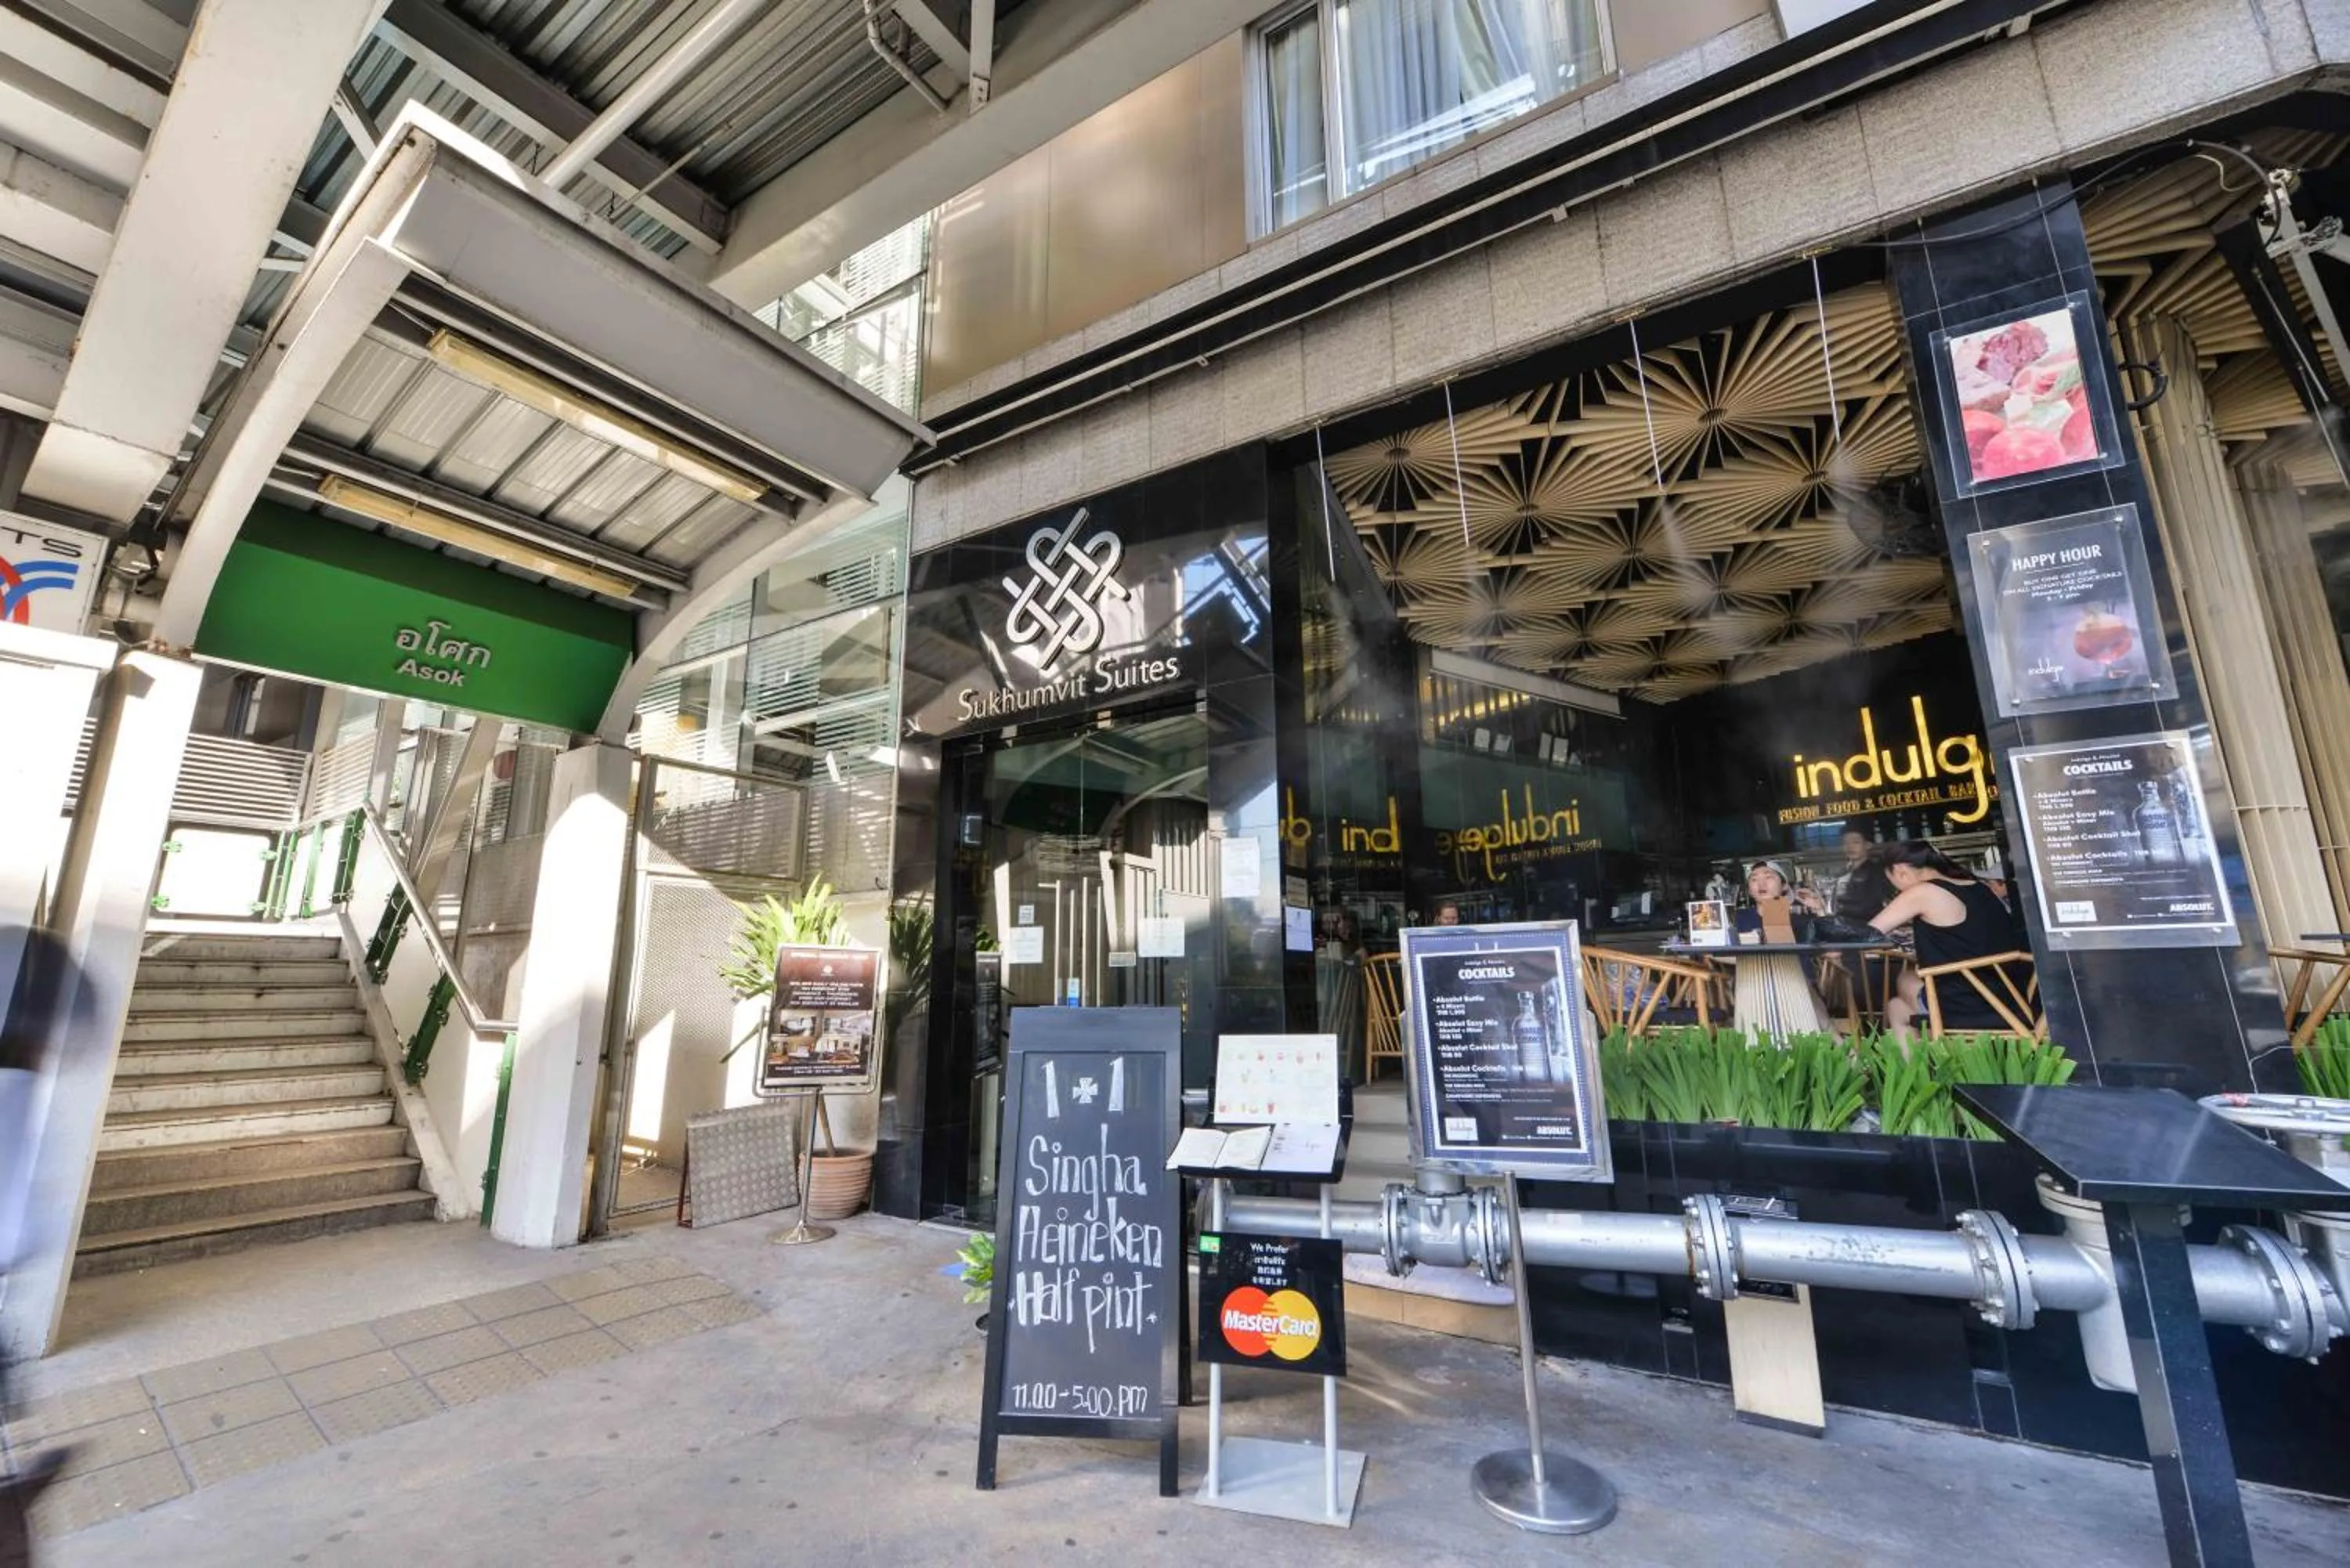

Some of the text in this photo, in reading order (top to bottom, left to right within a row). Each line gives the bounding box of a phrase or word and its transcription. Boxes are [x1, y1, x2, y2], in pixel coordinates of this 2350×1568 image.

[0, 526, 83, 558] TS
[2012, 544, 2102, 571] HAPPY HOUR
[396, 621, 491, 669] อโศก
[396, 659, 465, 687] Asok
[957, 656, 1180, 722] Sukhumvit Suites
[2063, 759, 2133, 775] COCKTAILS
[1826, 800, 1861, 816] FOOD
[1878, 786, 1940, 807] COCKTAIL
[1458, 966, 1515, 980] COCKTAILS
[1025, 1123, 1147, 1221] Singha
[1018, 1197, 1163, 1267] Heineken
[1250, 1242, 1289, 1254] We Prefer
[1016, 1268, 1080, 1326] Half
[1224, 1309, 1318, 1339] MasterCard
